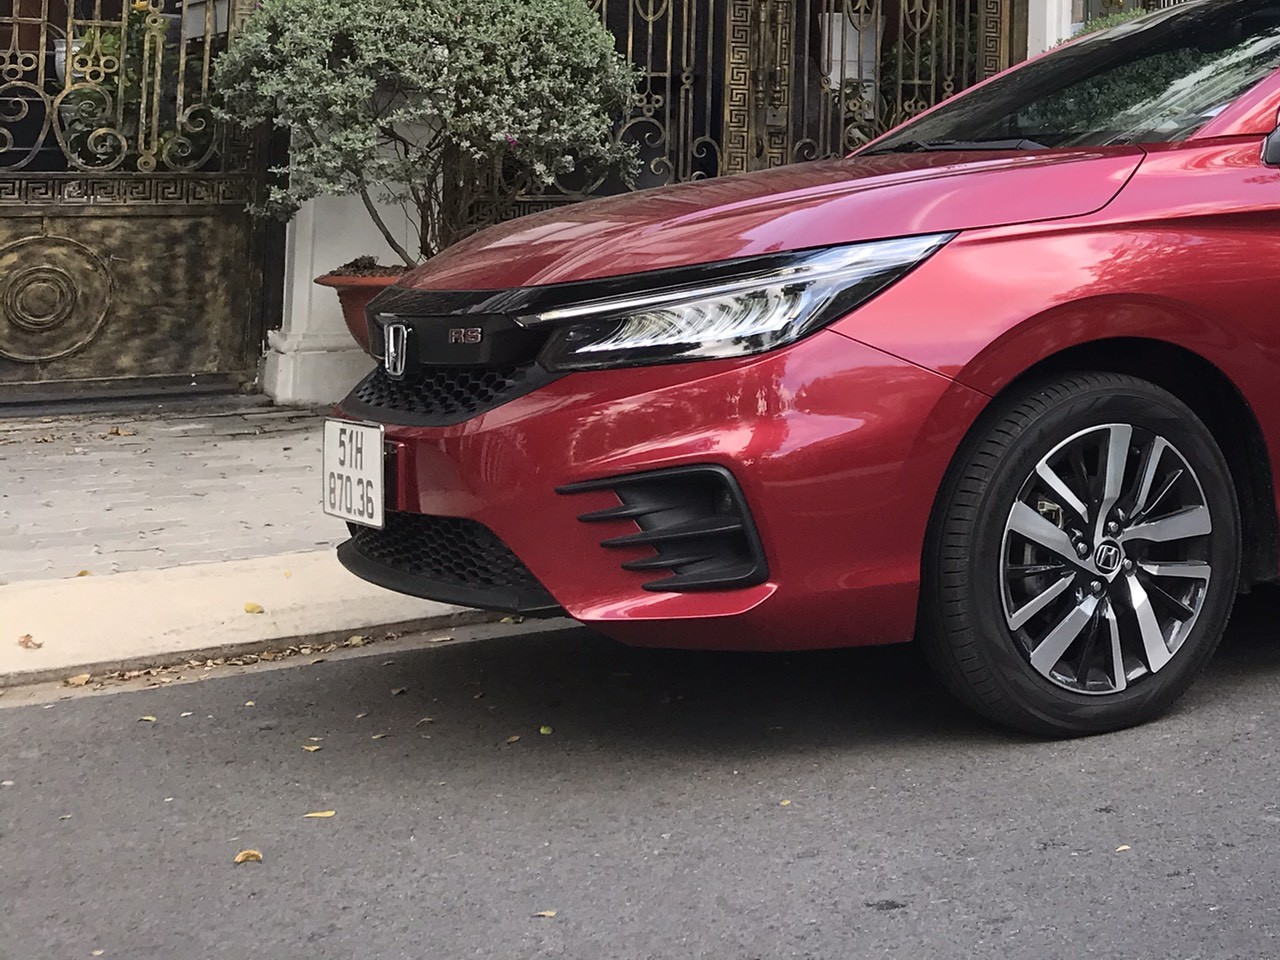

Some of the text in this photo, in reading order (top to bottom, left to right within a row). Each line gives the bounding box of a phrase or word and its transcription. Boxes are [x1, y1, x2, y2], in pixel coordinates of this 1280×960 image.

[449, 327, 482, 344] RS
[338, 428, 364, 471] 51H
[328, 471, 375, 520] 870.36
